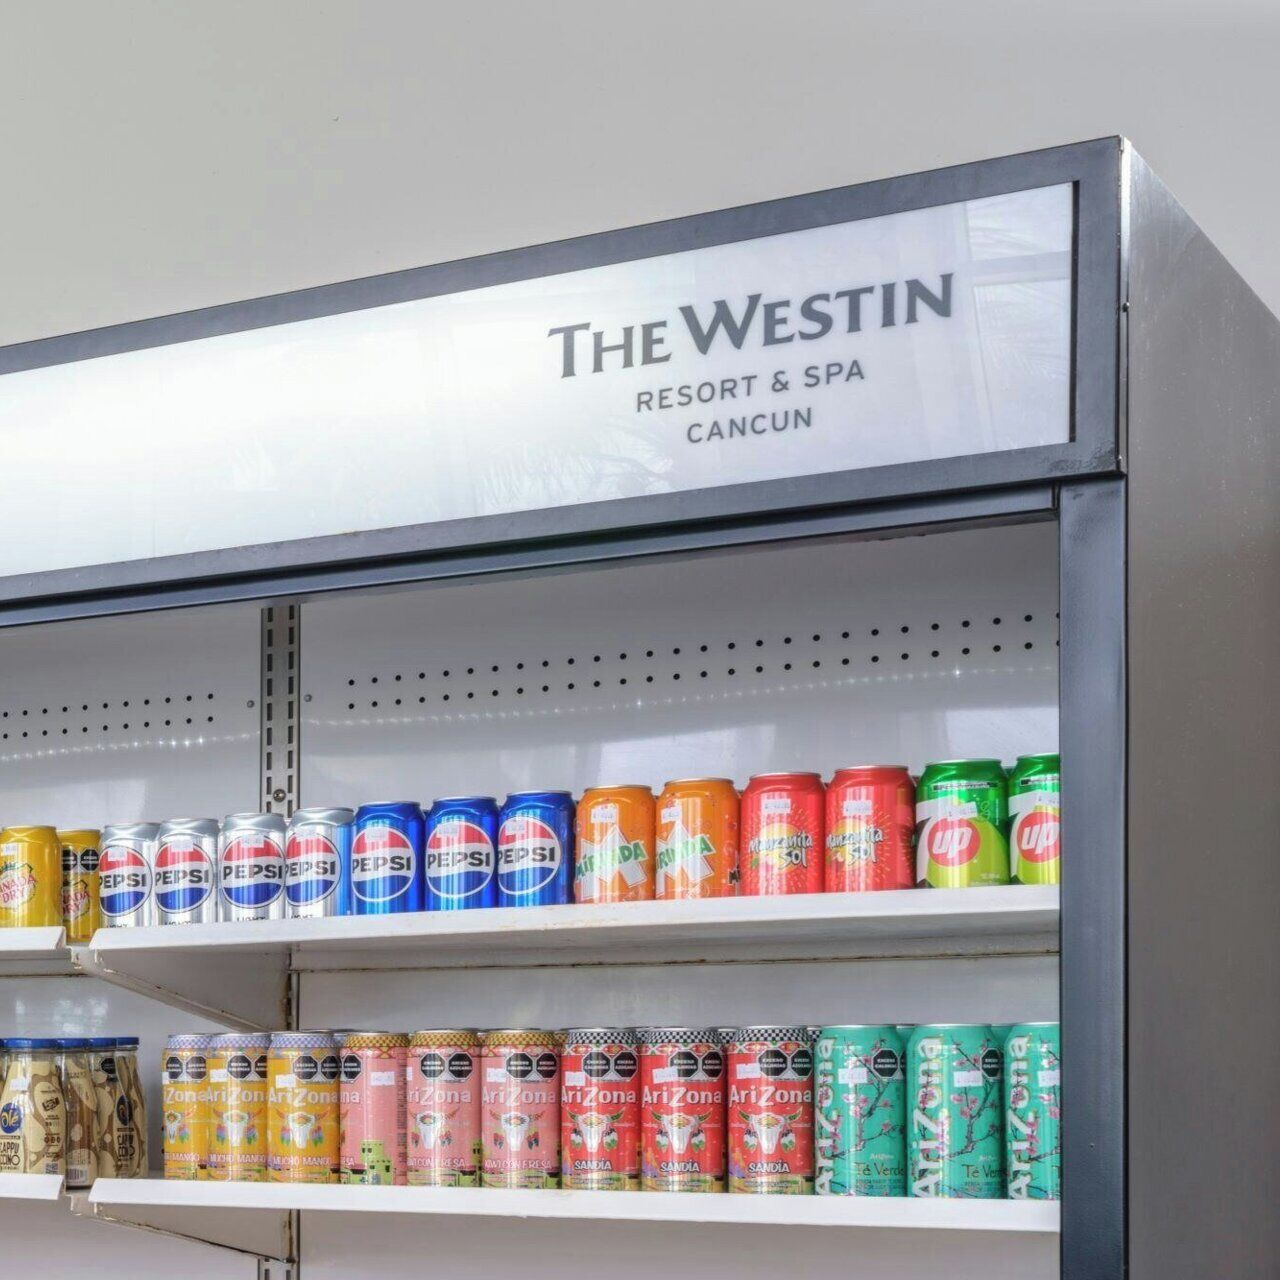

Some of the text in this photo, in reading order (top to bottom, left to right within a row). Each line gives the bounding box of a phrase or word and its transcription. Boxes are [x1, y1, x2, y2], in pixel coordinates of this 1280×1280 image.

[547, 273, 954, 379] THE WESTIN
[636, 359, 865, 413] RESORT & SPA
[686, 407, 813, 444] CANCUN
[353, 855, 411, 874] PEPSI
[427, 851, 490, 869] PEPSI
[155, 869, 209, 887] PEPSI
[223, 865, 282, 881] PEPSI
[268, 1086, 341, 1107] AriZona
[482, 1086, 557, 1107] AriZona
[561, 1085, 636, 1107] AriZona
[642, 1085, 721, 1107] AriZona
[729, 1084, 811, 1107] AriZona
[574, 1159, 612, 1171] SANDÍA
[660, 1159, 700, 1173] SANDÍA
[748, 1159, 791, 1174] SANDÍA
